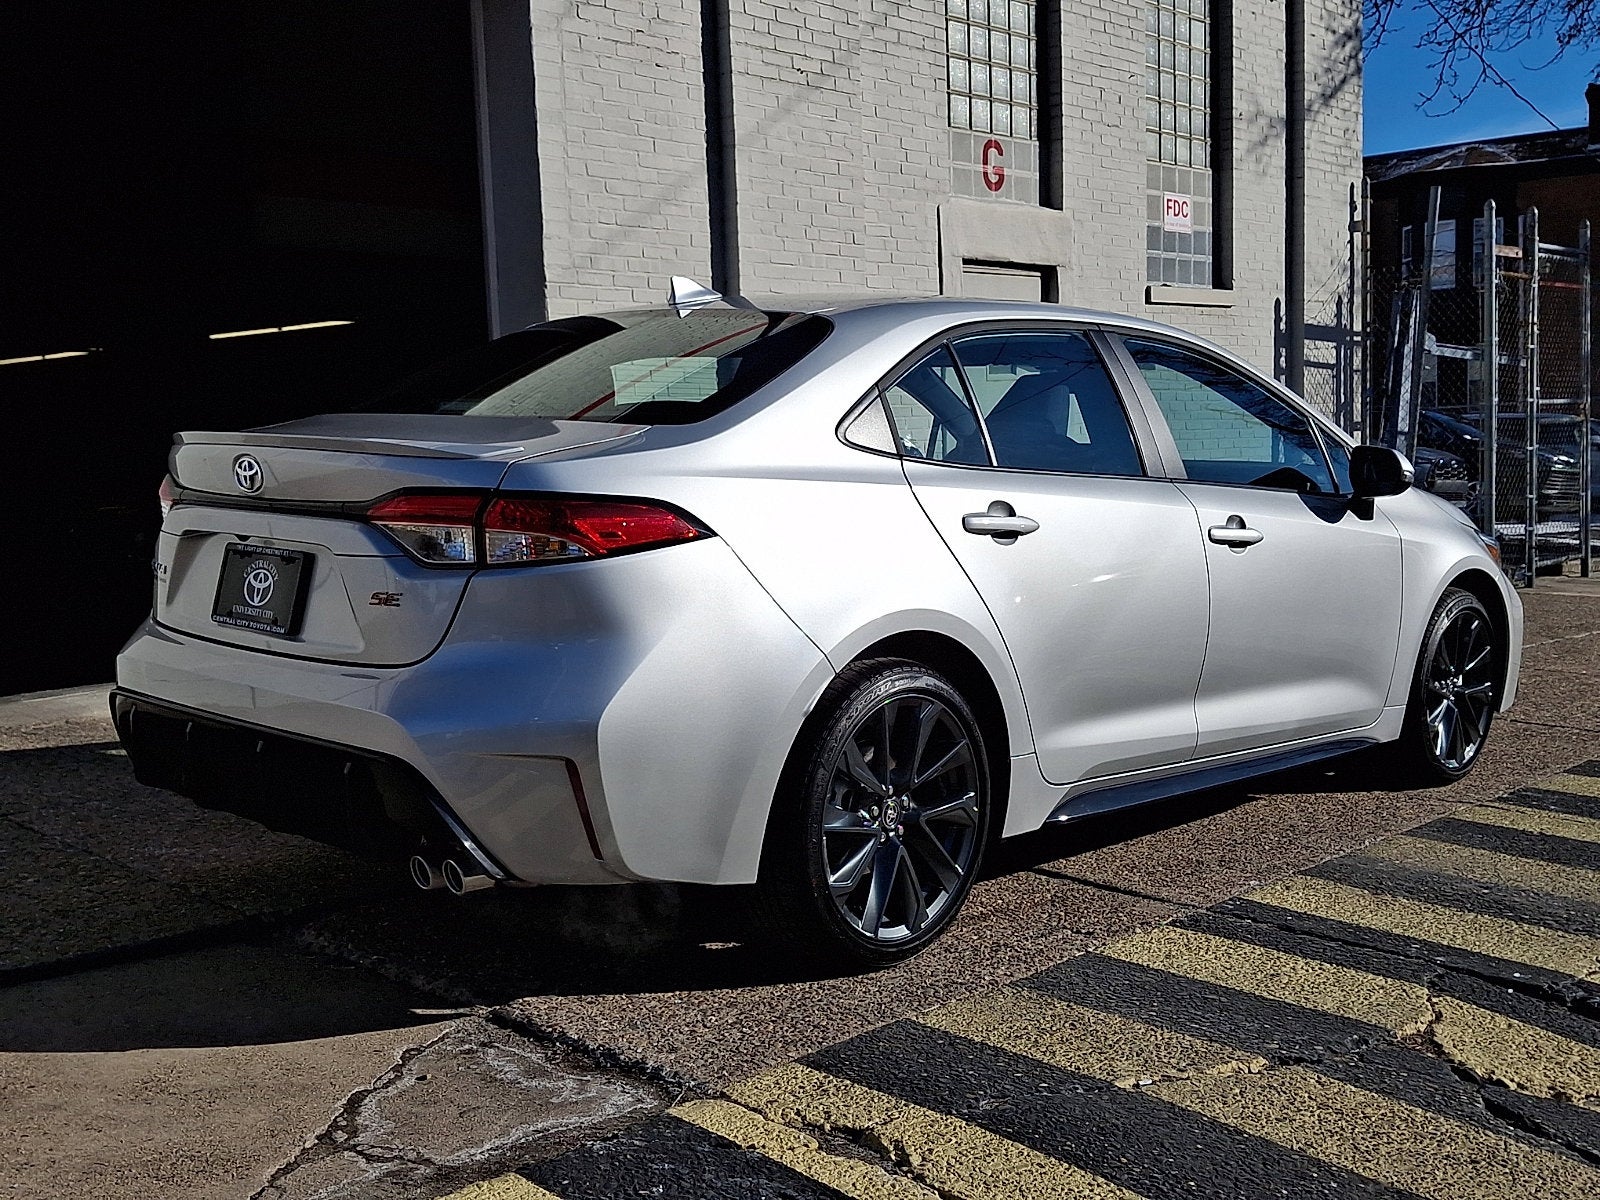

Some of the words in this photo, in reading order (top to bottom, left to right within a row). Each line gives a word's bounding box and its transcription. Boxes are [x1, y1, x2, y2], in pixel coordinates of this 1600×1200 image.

[982, 139, 1005, 191] G
[1166, 198, 1189, 218] FDC
[243, 560, 269, 578] CENTRAL
[268, 563, 279, 581] CITY
[369, 591, 403, 607] SE
[232, 604, 262, 617] UNIVERSITY
[262, 610, 273, 619] CITY
[212, 615, 236, 625] CENTRAL
[236, 619, 249, 628] CITY
